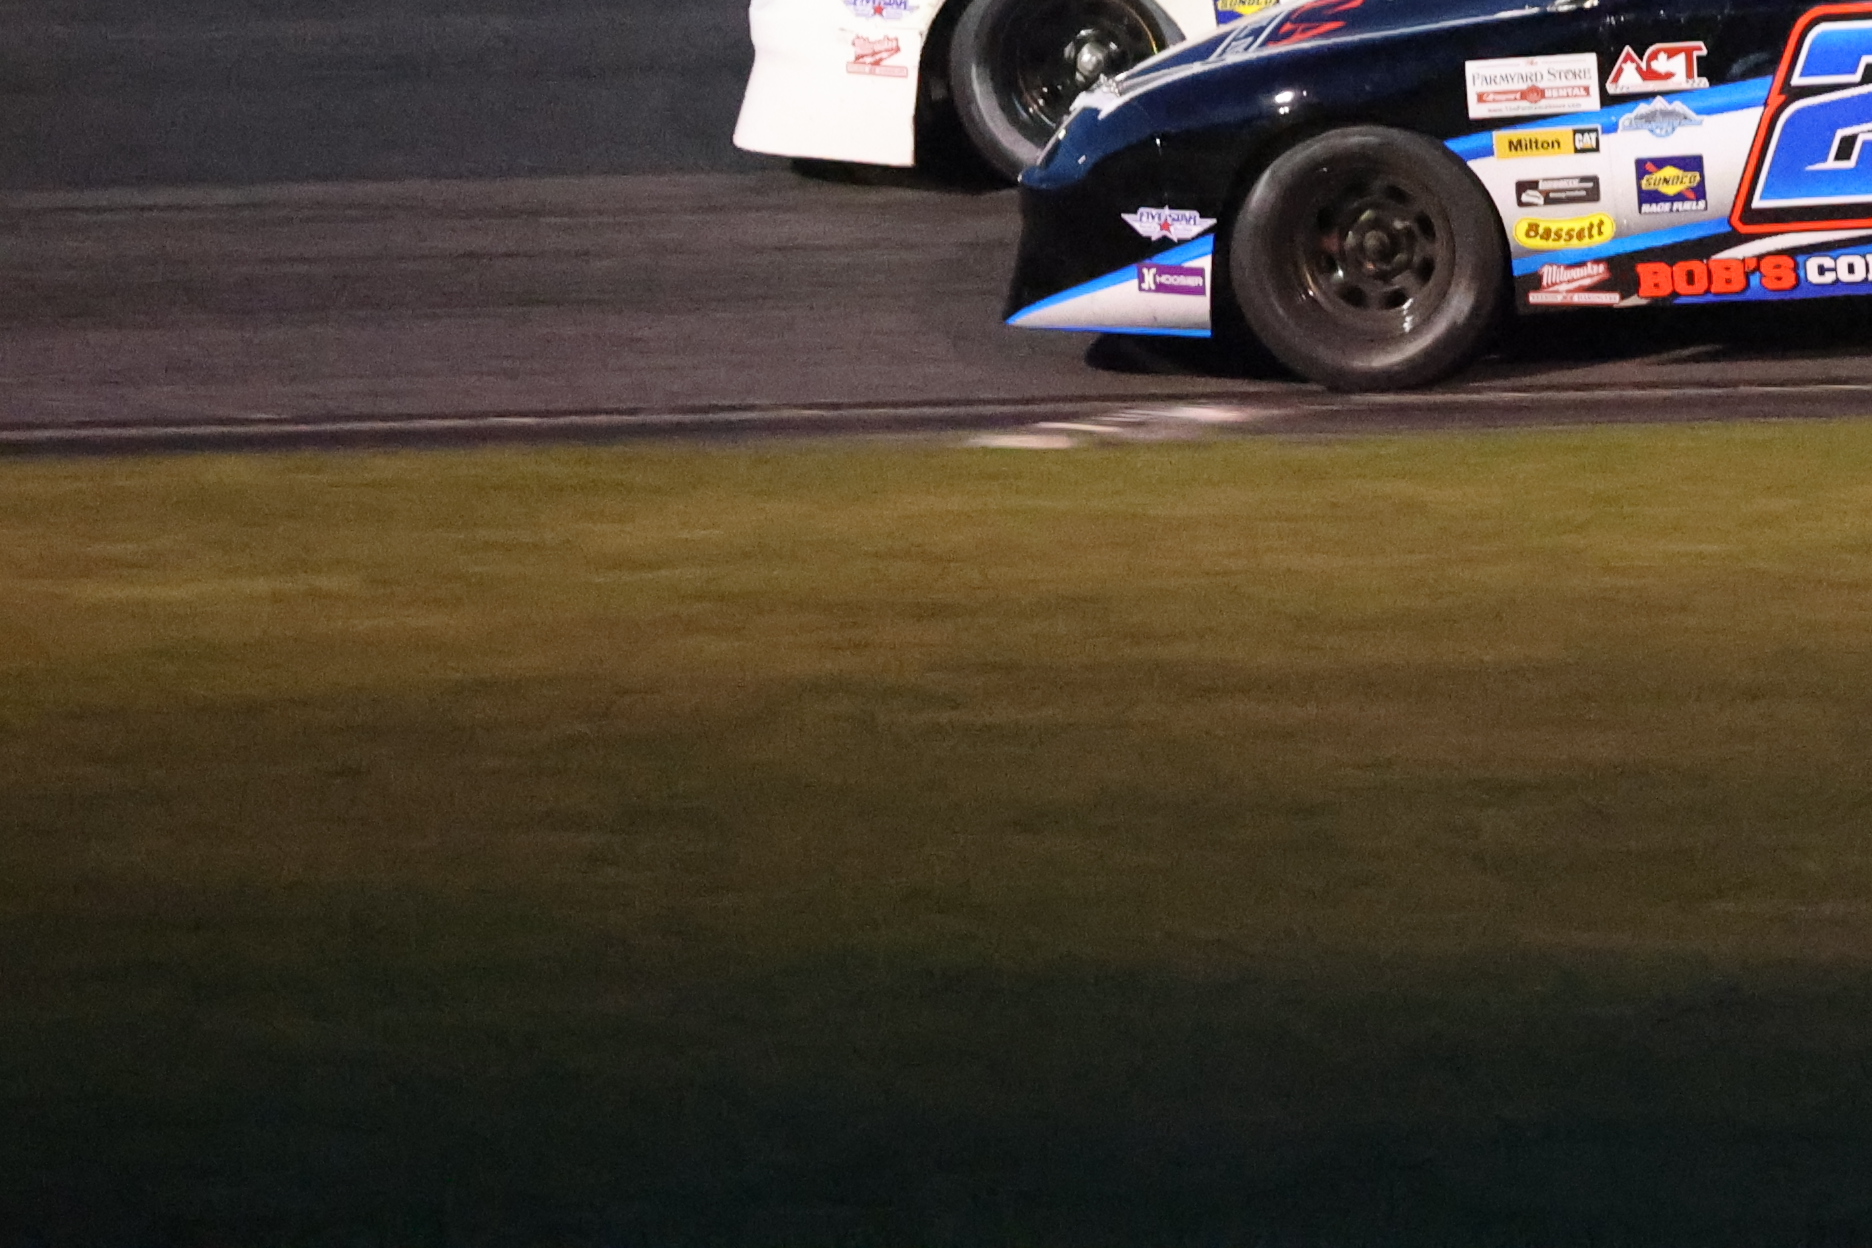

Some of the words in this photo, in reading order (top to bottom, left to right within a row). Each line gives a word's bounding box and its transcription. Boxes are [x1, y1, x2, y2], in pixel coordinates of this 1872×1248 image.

[1609, 44, 1705, 84] ACT
[1472, 71, 1544, 87] FARMYARD
[1547, 67, 1592, 82] STORE
[1508, 137, 1561, 153] Milton
[1574, 132, 1597, 150] CAT
[1645, 173, 1698, 188] SUNOCO
[1524, 218, 1607, 242] Bassett
[1636, 254, 1798, 298] BOB'S
